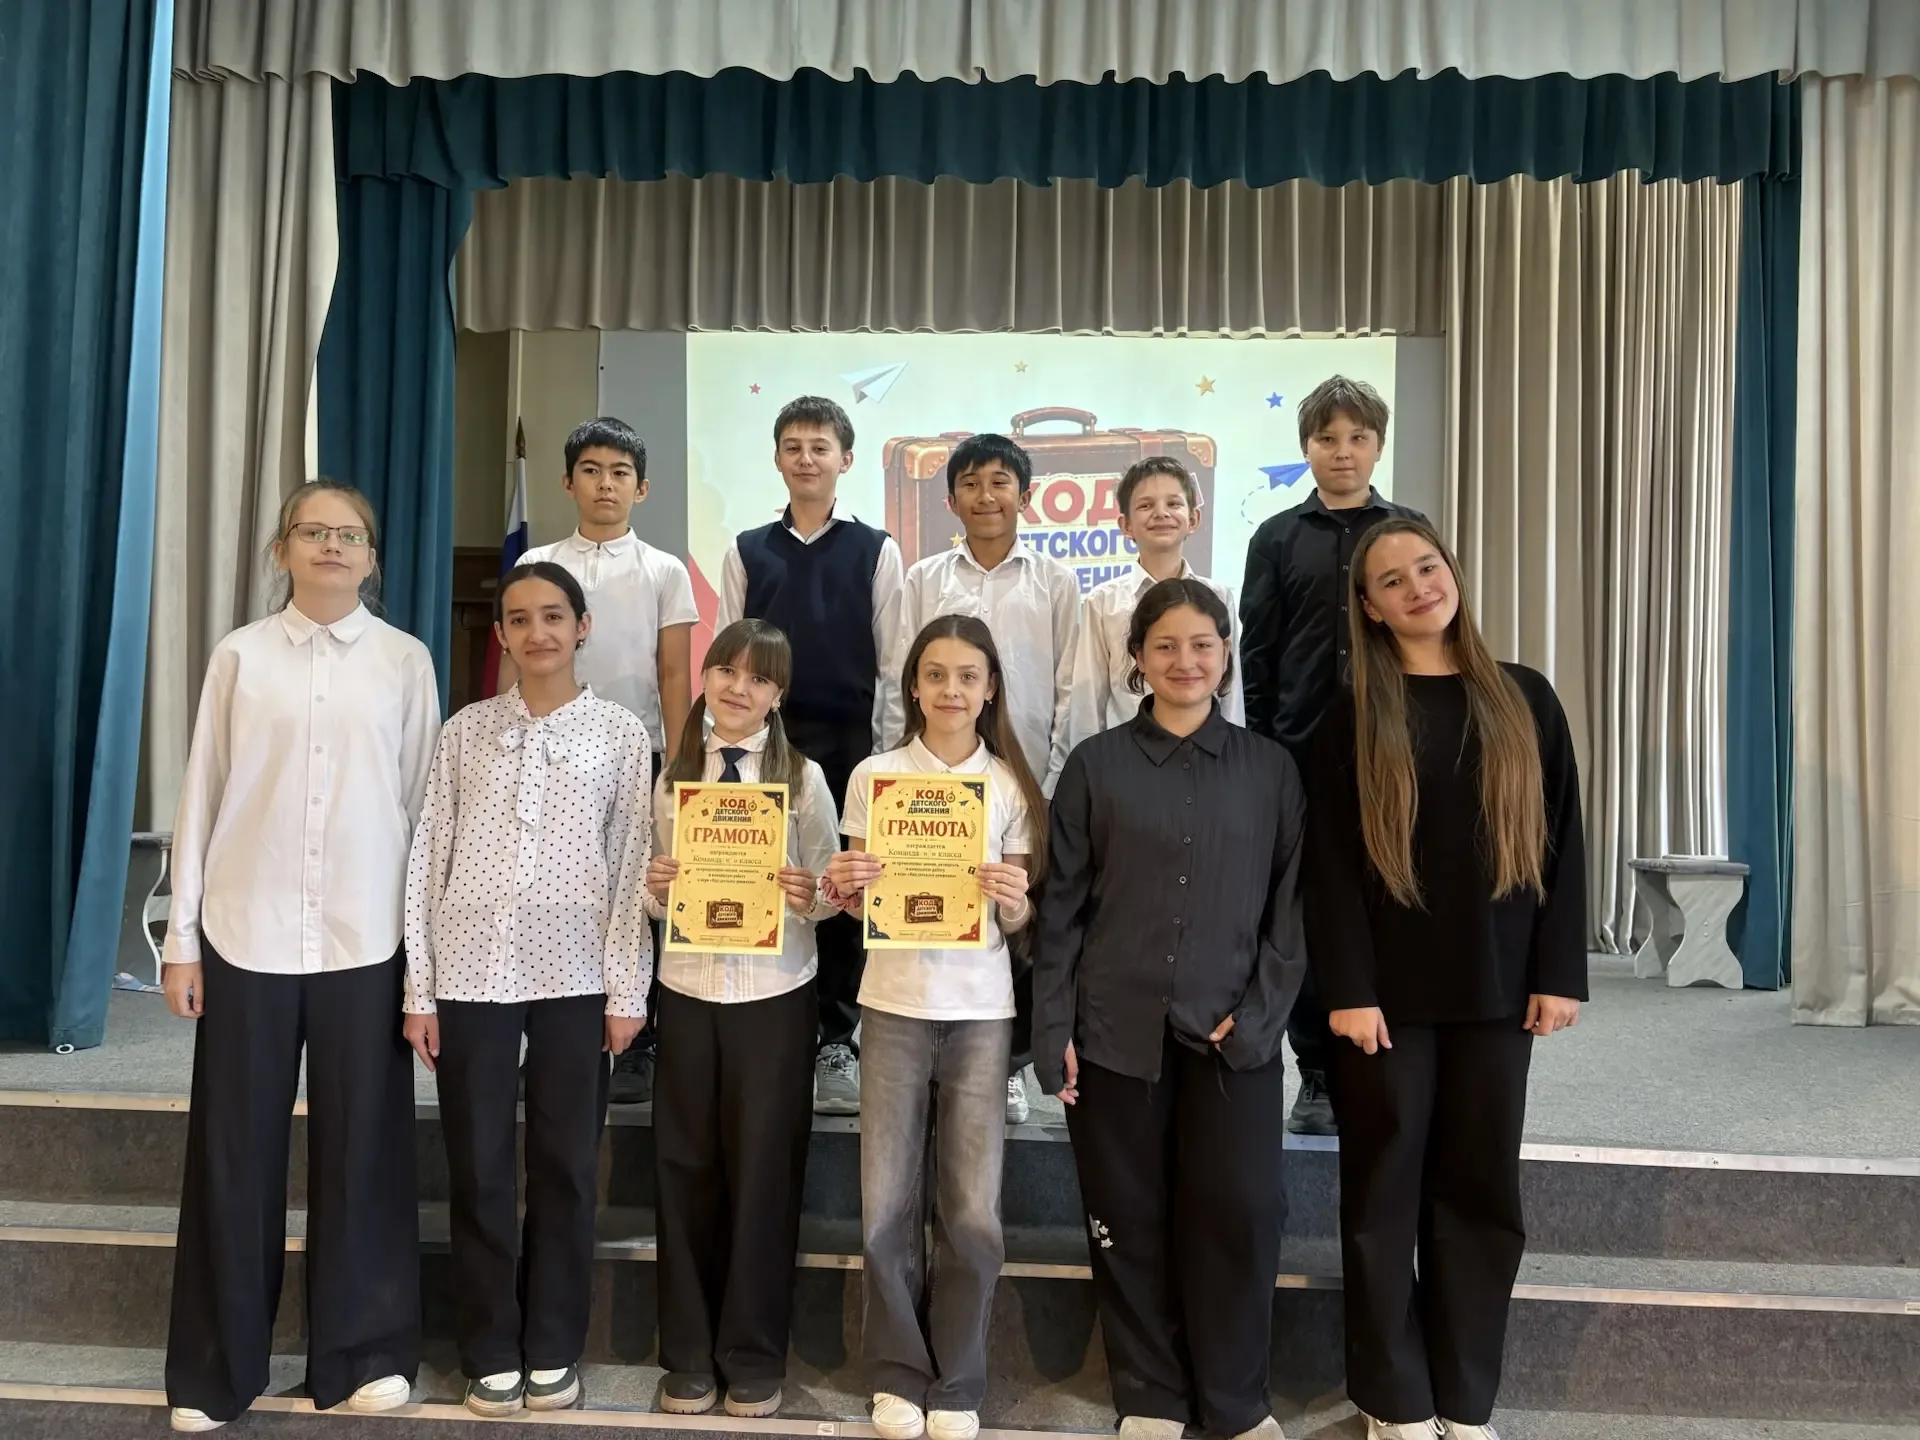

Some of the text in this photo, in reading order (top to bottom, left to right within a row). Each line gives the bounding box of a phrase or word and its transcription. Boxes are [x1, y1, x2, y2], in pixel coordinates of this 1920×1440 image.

[915, 789, 945, 801] КОД
[719, 798, 747, 809] КОД
[714, 808, 749, 816] ДЕТСКОГО
[907, 807, 950, 815] ДВИЖЕНИЯ
[711, 815, 752, 823] ДВИЖЕНИЯ
[887, 819, 969, 838] ГРАМОТА
[692, 826, 769, 845] ГРАМОТА
[937, 851, 962, 859] класса
